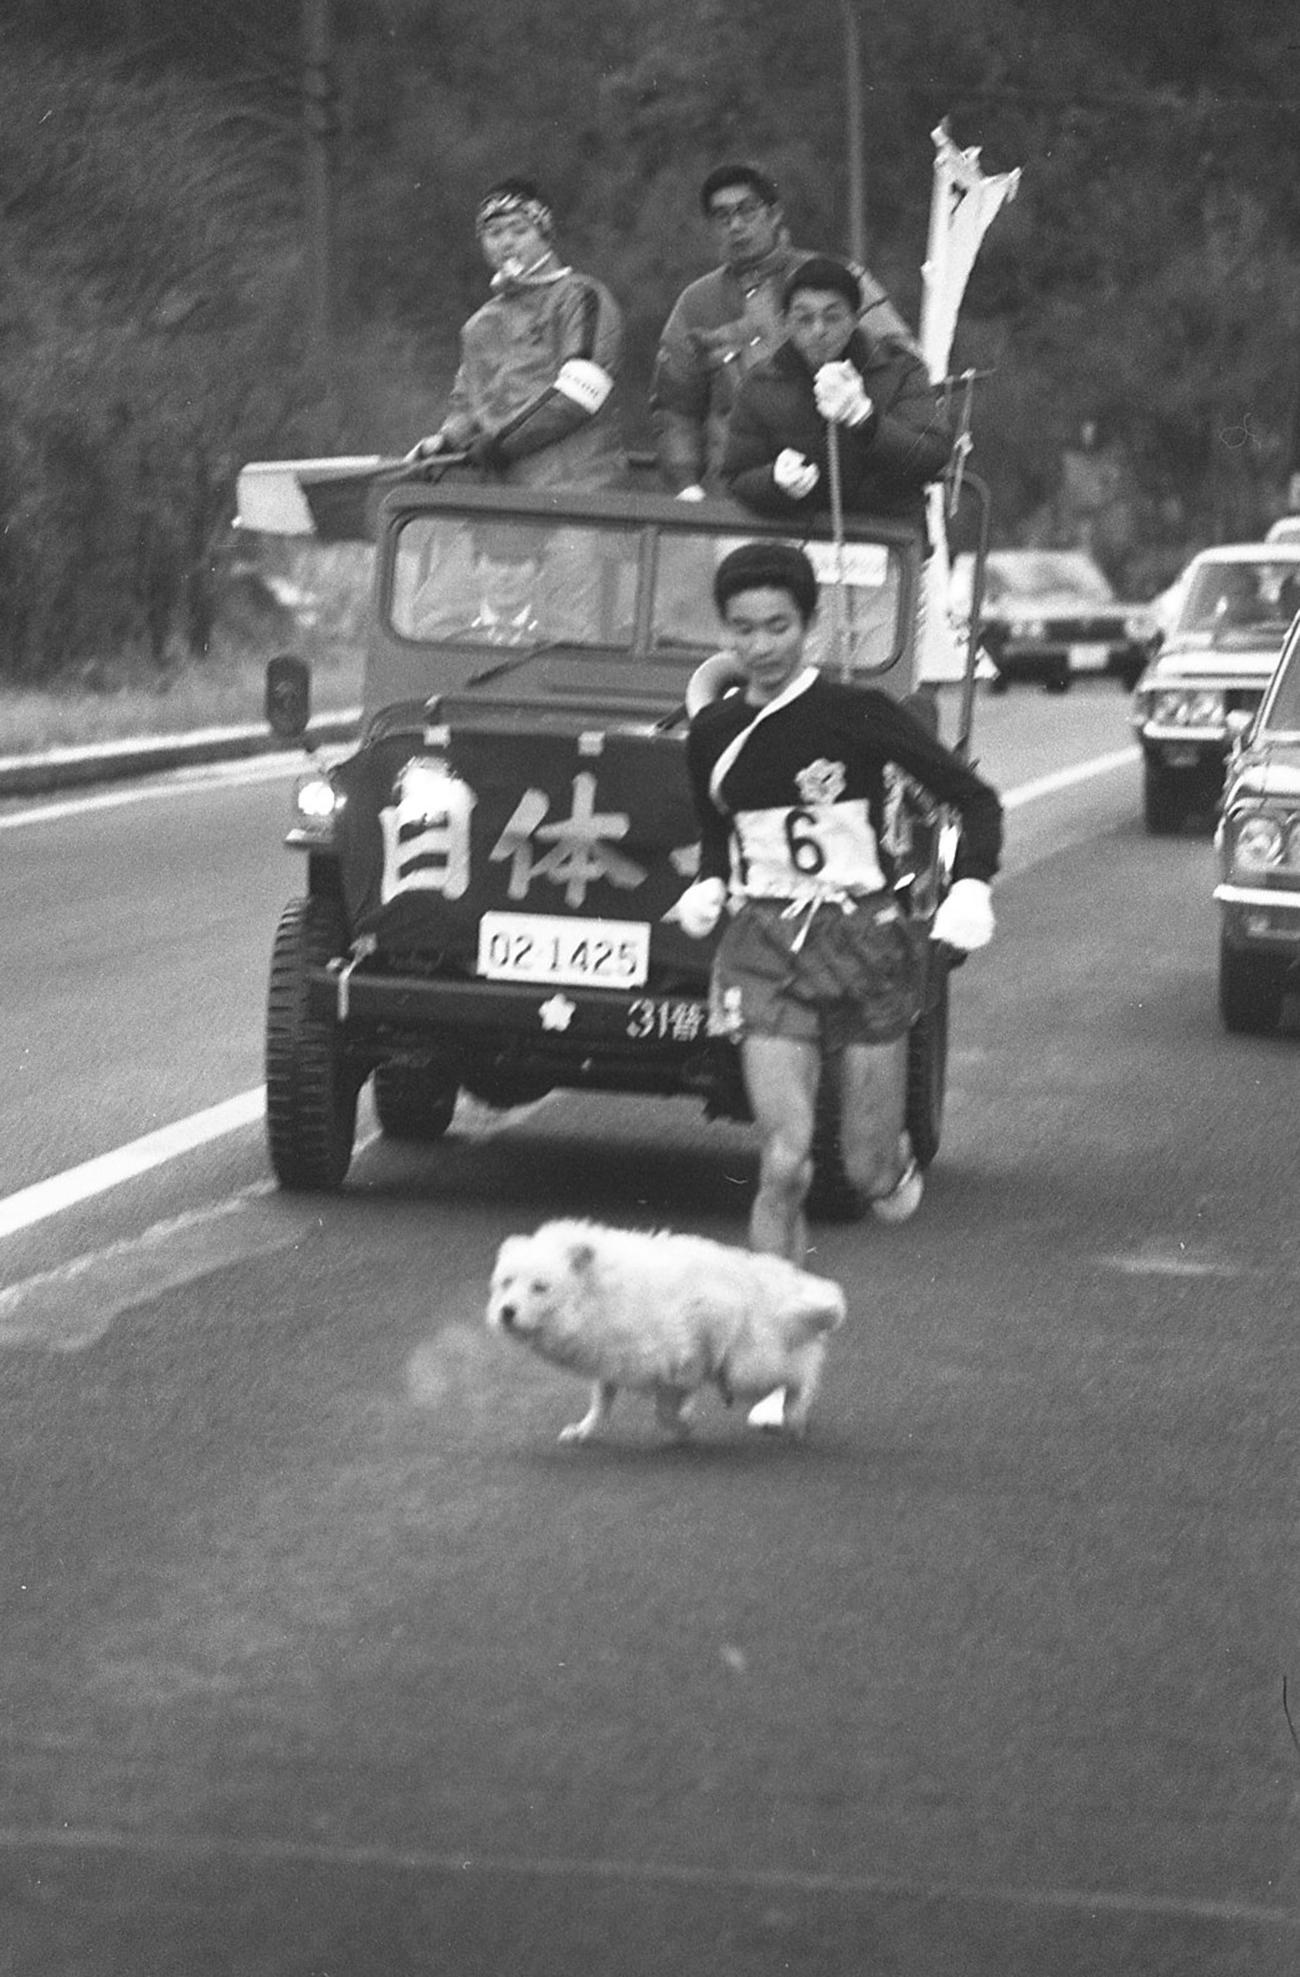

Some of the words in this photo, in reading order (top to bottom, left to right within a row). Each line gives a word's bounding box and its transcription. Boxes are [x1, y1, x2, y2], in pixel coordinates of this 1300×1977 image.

[378, 772, 701, 908] 日体
[785, 808, 826, 876] 6
[489, 932, 533, 969] 02
[551, 936, 637, 976] 1425
